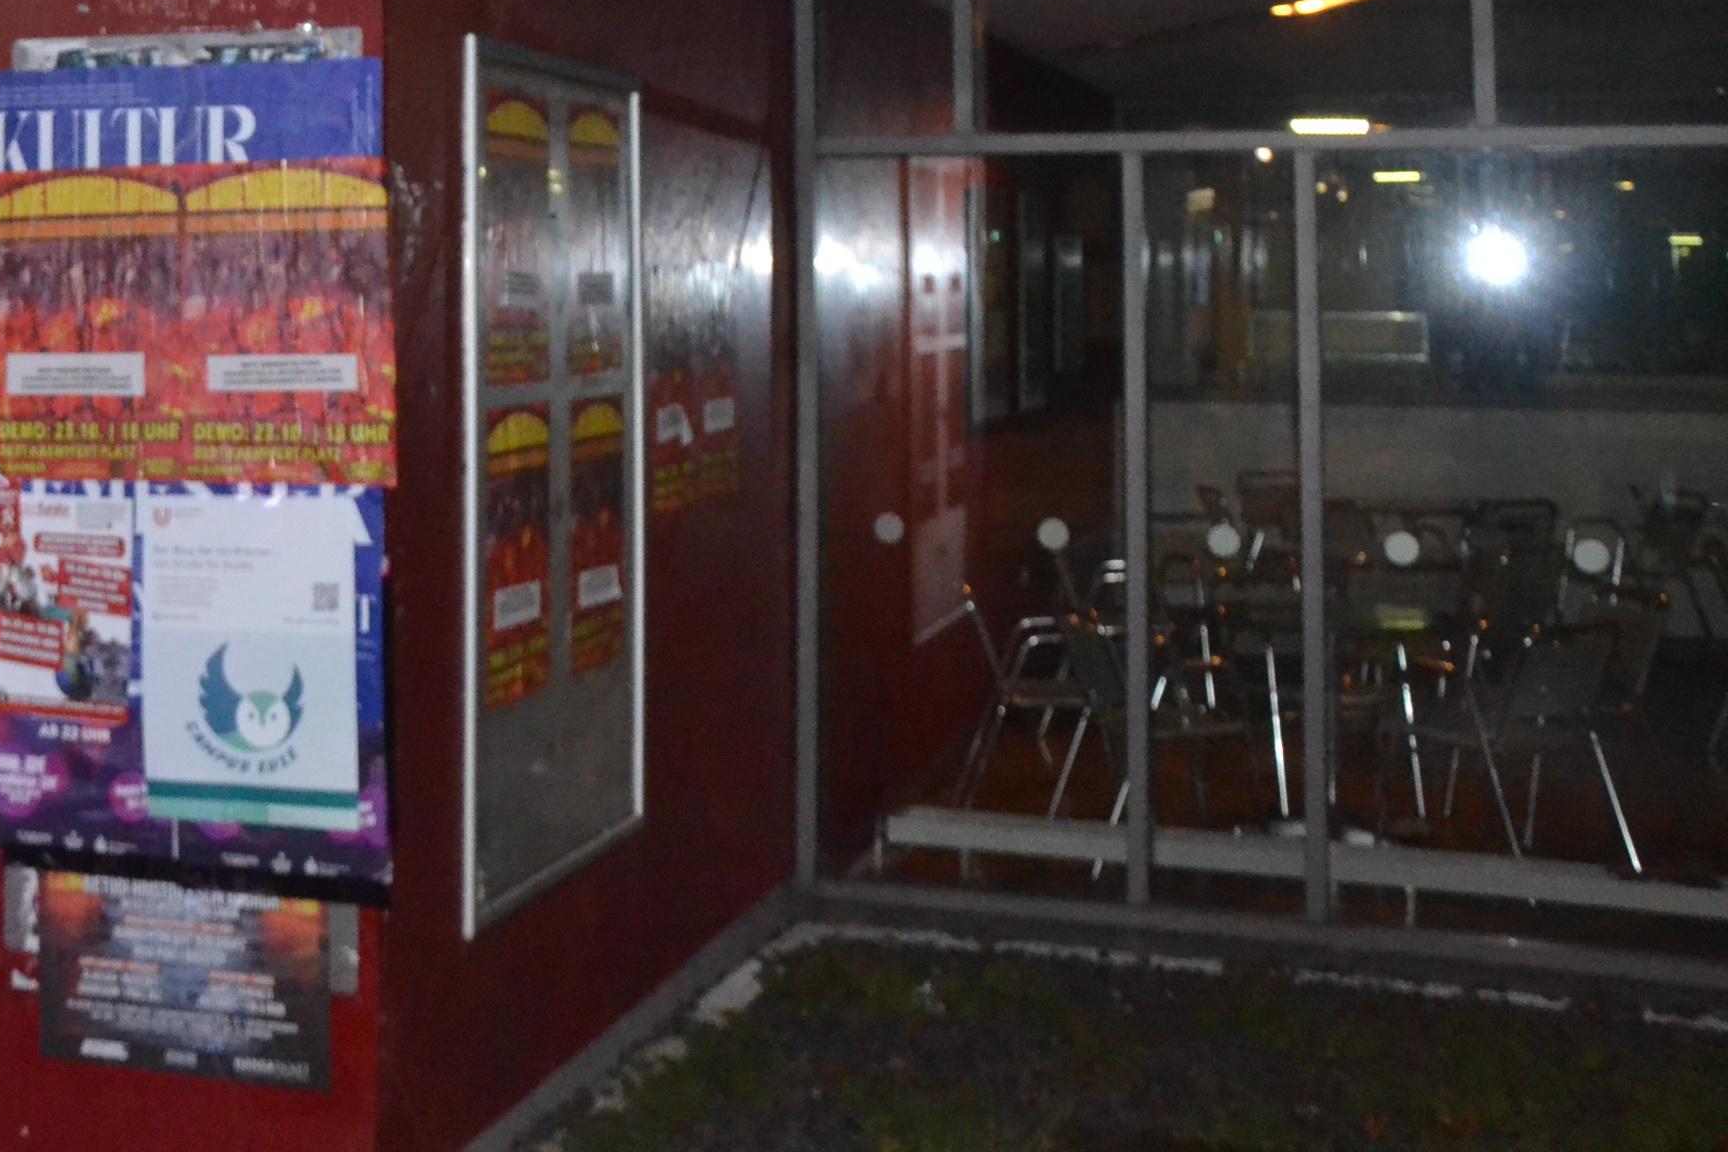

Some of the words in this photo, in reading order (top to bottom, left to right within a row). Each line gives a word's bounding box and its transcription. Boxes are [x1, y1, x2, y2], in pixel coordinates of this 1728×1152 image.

[144, 421, 181, 442] UHR
[350, 423, 390, 445] UHR
[81, 724, 112, 744] UHR
[185, 720, 251, 774] CAMPUS
